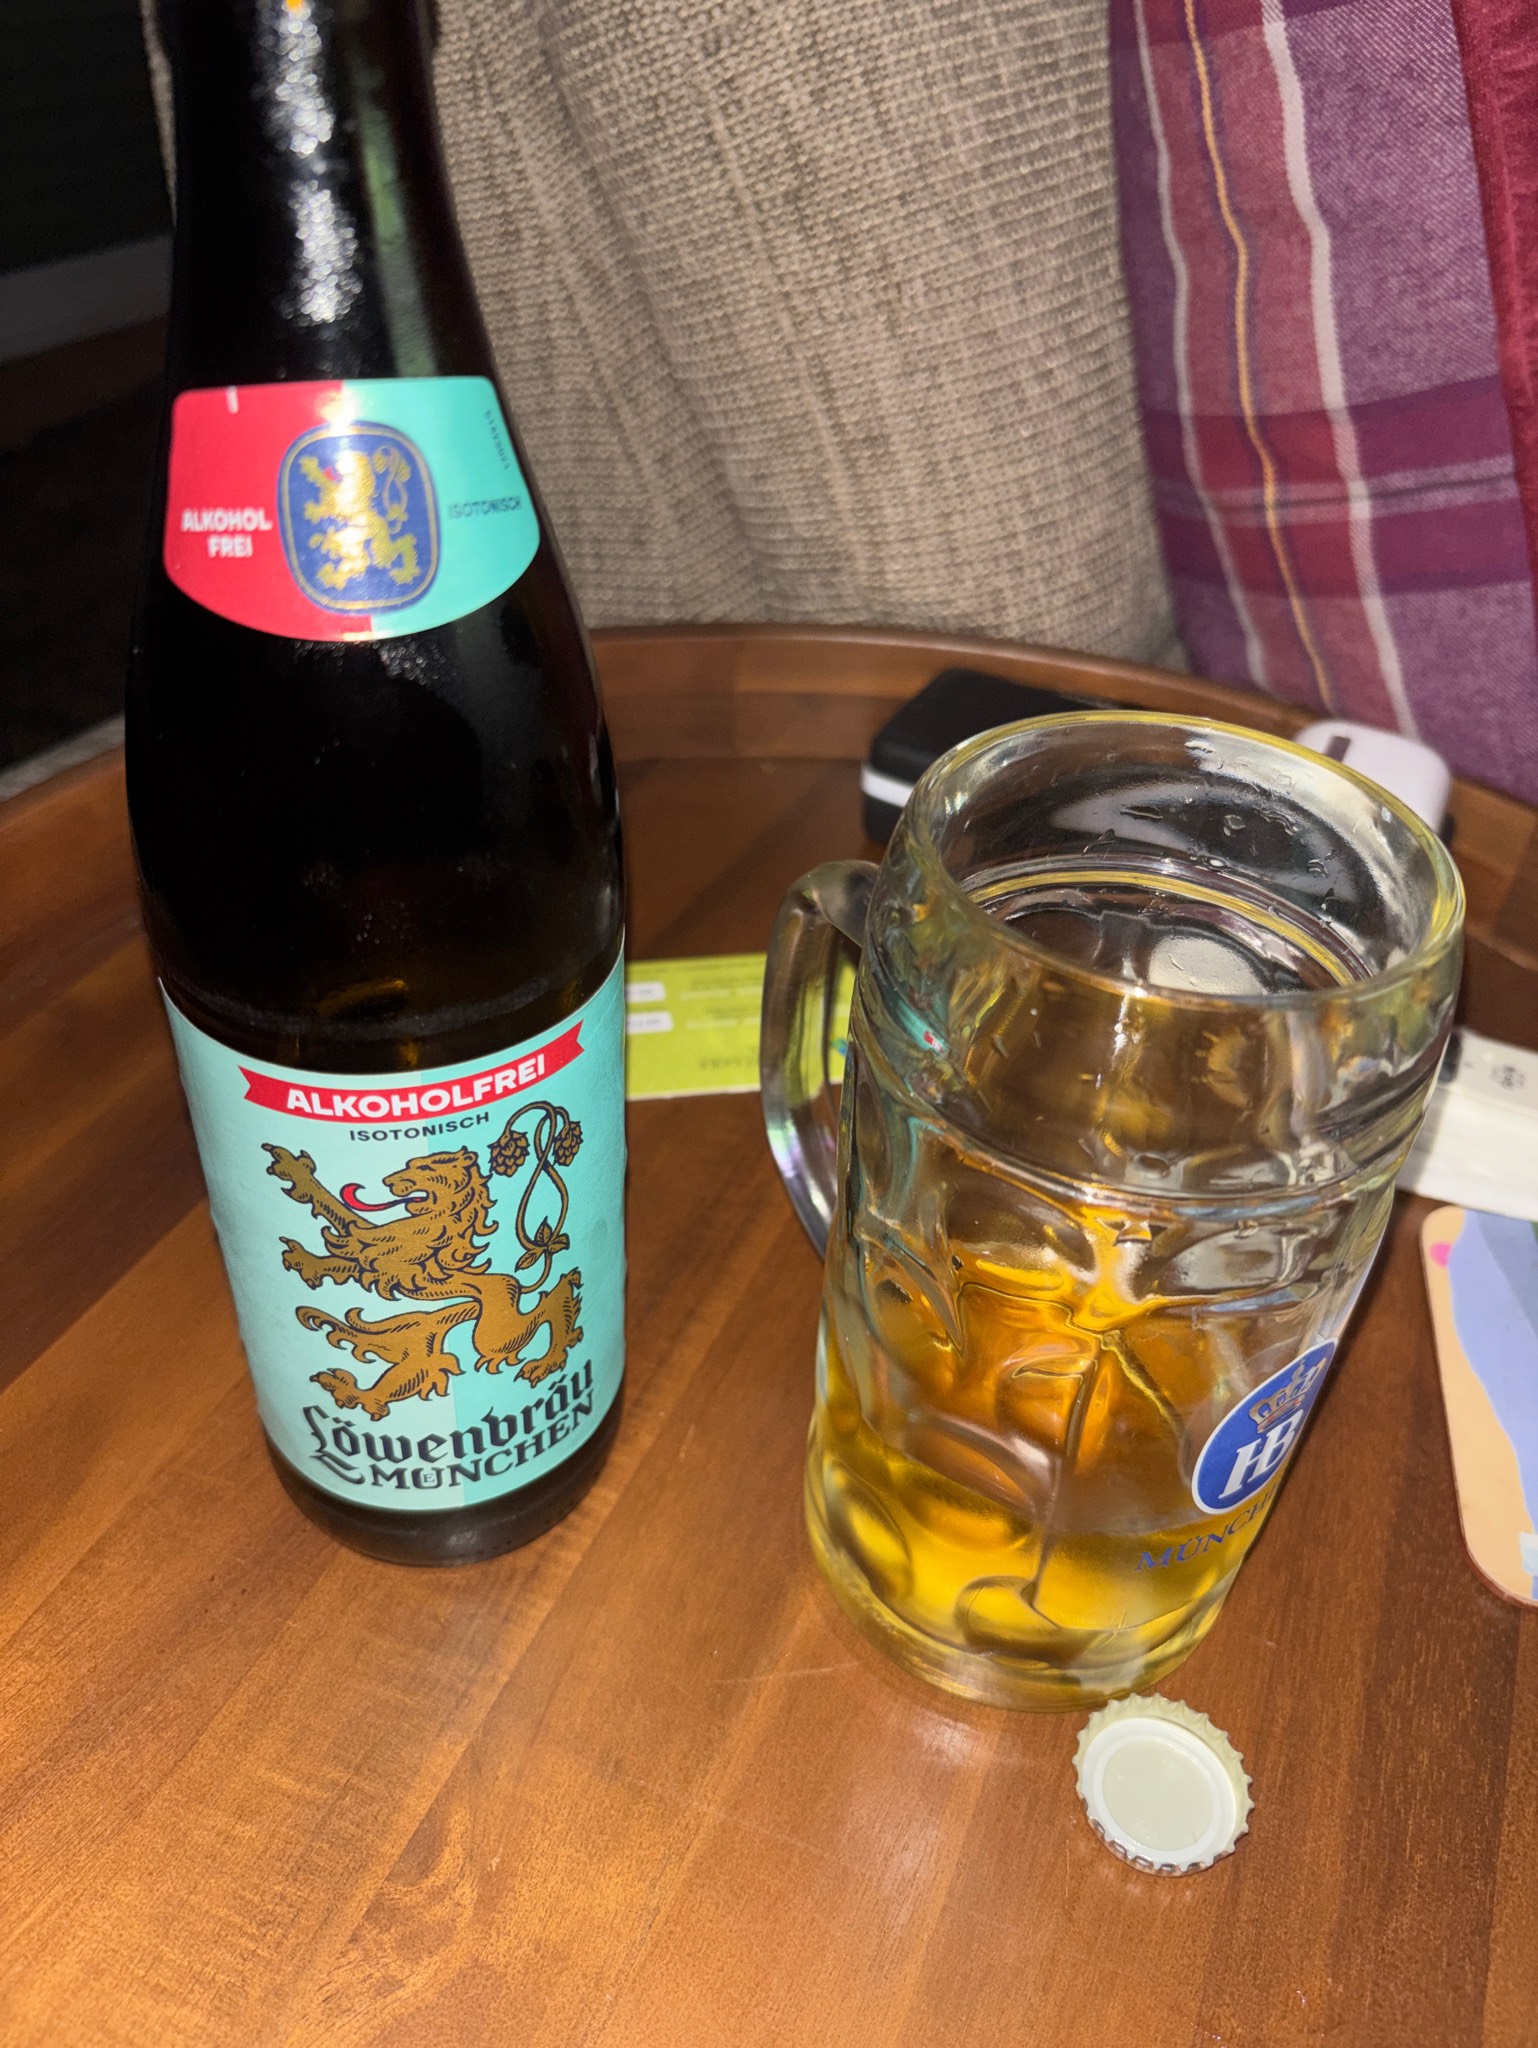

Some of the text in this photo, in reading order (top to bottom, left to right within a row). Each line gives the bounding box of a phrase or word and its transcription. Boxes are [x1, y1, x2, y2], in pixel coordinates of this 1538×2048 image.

[181, 508, 273, 532] ALKOHOL
[448, 496, 521, 521] ISOTONISCH
[207, 536, 253, 558] FREI
[286, 1053, 546, 1119] ALKOHOLFREI
[349, 1111, 490, 1142] ISOTONISCH
[302, 1359, 594, 1485] Löwenbräu
[1218, 1408, 1304, 1499] HB
